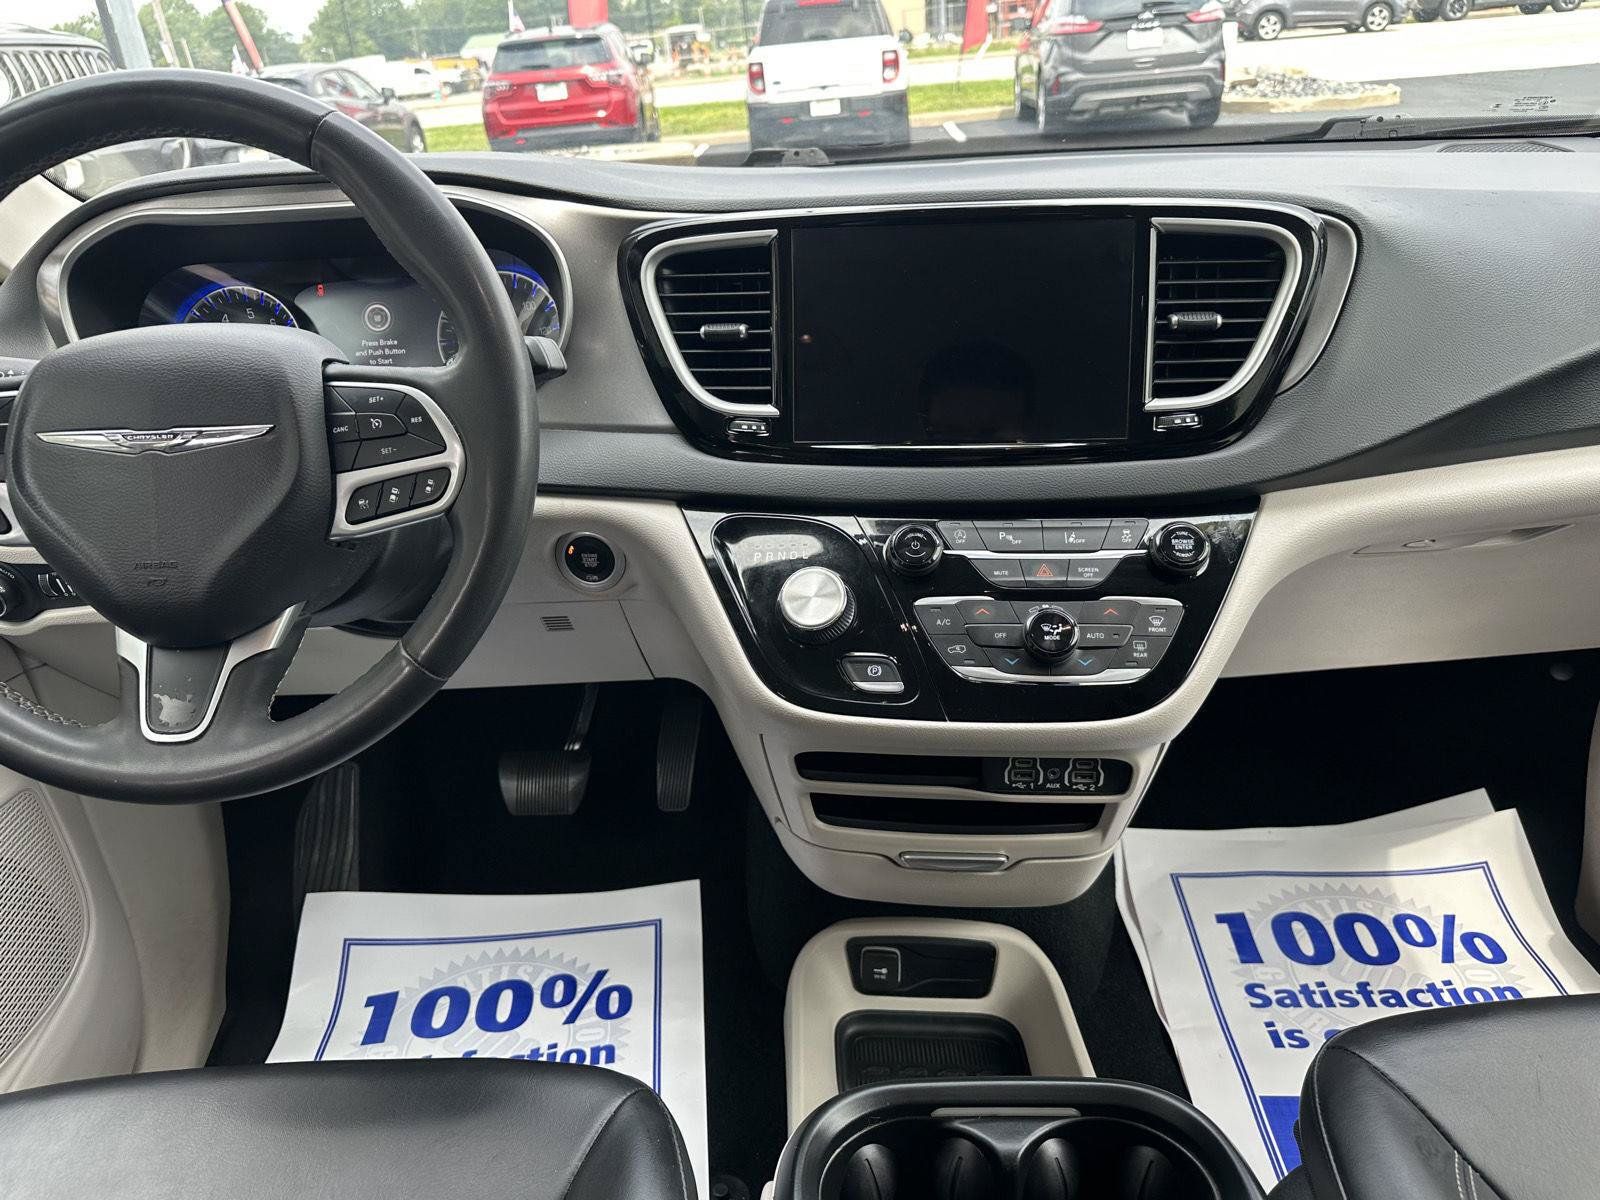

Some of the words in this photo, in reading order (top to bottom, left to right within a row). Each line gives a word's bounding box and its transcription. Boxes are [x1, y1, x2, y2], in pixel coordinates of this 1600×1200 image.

[246, 308, 255, 319] 5
[127, 433, 174, 441] CHRYSLER
[332, 425, 349, 433] CANC
[134, 560, 179, 569] AIRBAG
[1214, 911, 1508, 966] 100%
[1244, 979, 1524, 1009] Satisfaction
[360, 968, 633, 1046] 100%
[1264, 1020, 1310, 1049] is
